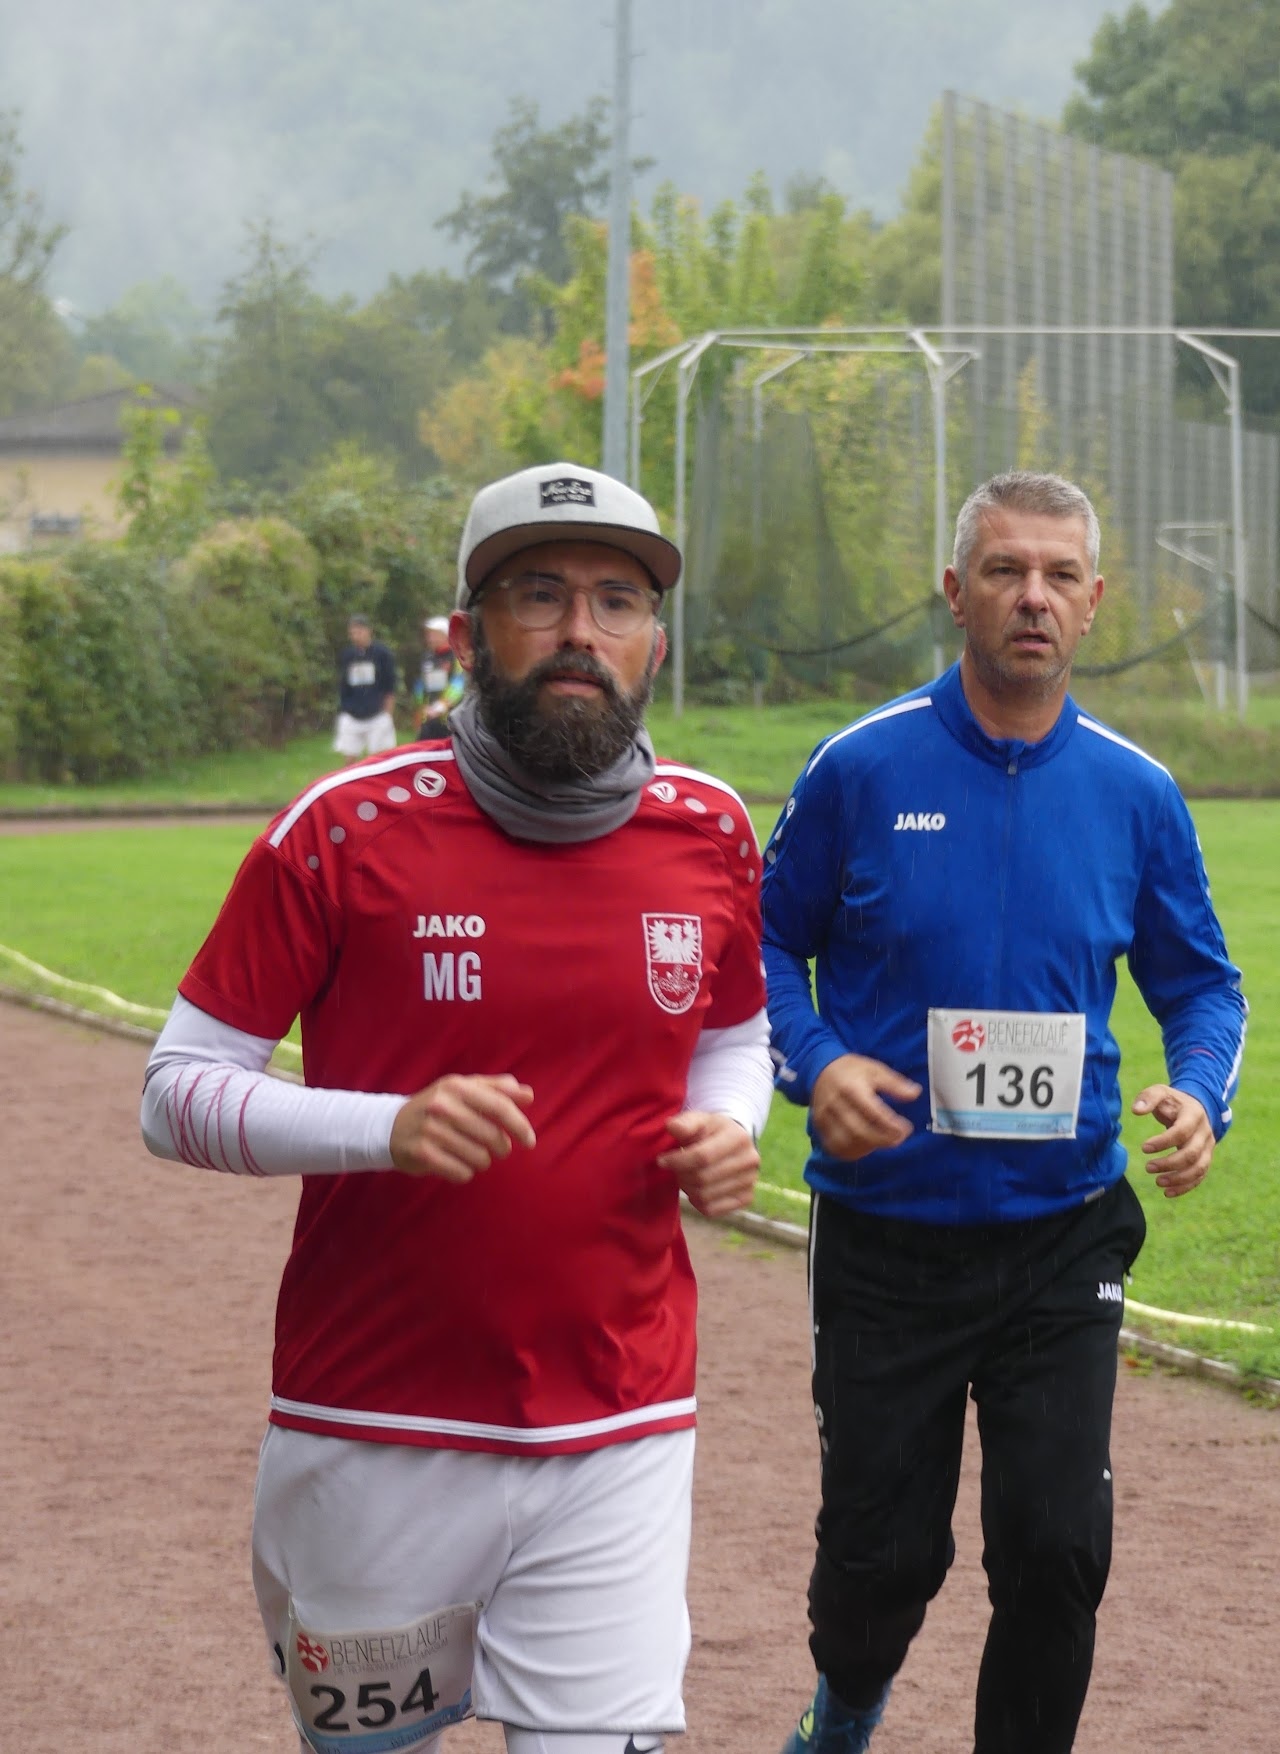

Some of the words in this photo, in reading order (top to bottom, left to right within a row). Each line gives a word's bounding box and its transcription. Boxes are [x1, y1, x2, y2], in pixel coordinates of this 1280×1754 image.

[893, 812, 946, 831] JAKO
[412, 914, 486, 938] JAKO
[423, 951, 482, 1001] MG
[987, 1020, 1068, 1048] BENEFIZLAUF
[965, 1061, 1054, 1109] 136
[329, 1615, 448, 1667] BENEFIZLAUF
[310, 1665, 440, 1732] 254
